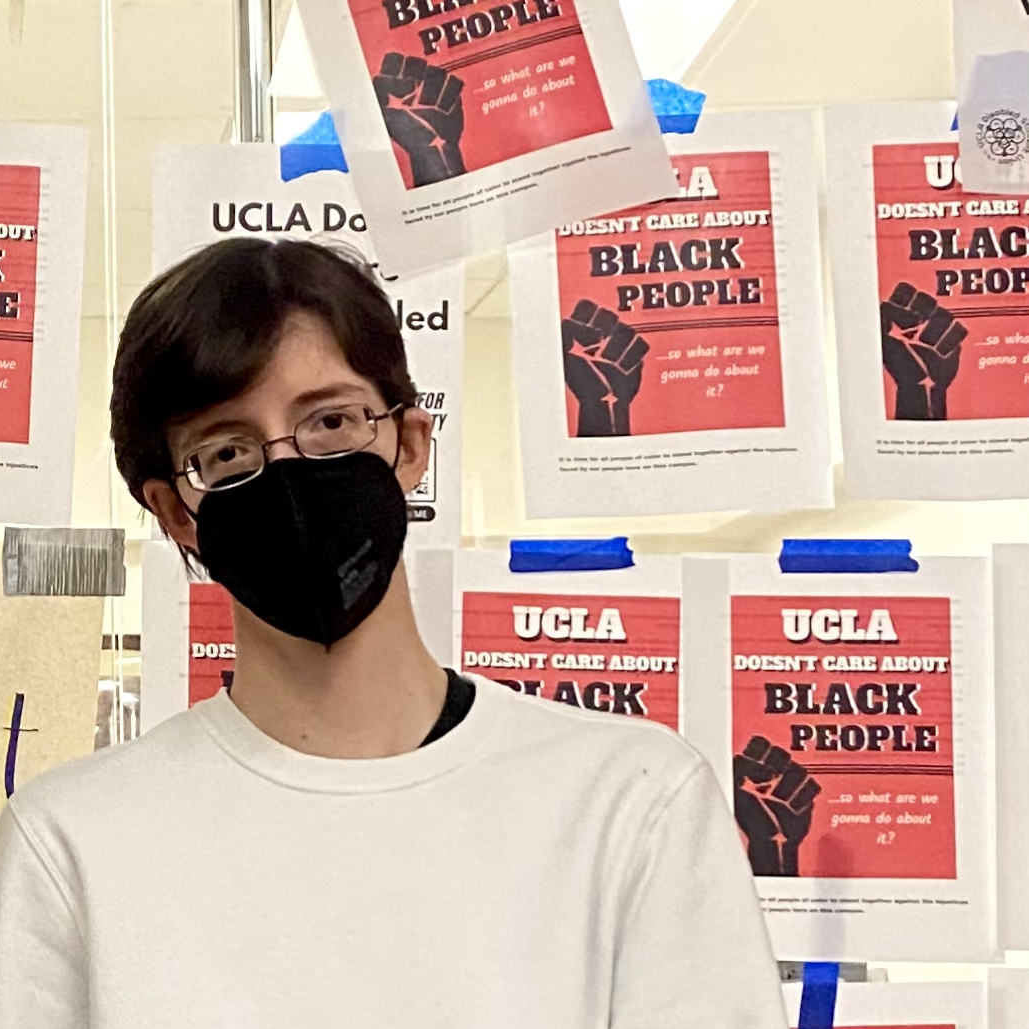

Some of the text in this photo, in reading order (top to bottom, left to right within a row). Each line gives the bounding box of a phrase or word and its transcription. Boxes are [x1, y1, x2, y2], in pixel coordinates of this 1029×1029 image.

[418, 0, 562, 56] PEOPLE
[501, 55, 576, 85] what are we
[482, 75, 575, 114] gonna do about
[529, 102, 545, 118] it?
[212, 203, 367, 232] UCLA Do
[645, 213, 698, 231] CARE
[703, 210, 769, 227] ABOUT
[966, 200, 1018, 217] CARE
[589, 237, 744, 278] BLACK
[908, 227, 1029, 261] BLAC
[617, 277, 761, 312] PEOPLE
[0, 359, 16, 369] we
[687, 345, 718, 358] what
[660, 364, 759, 383] gonna about
[513, 606, 626, 643] UCLA
[781, 608, 899, 644] UCLA
[552, 654, 605, 671] CARE
[609, 656, 676, 673] ABOUT
[822, 656, 877, 672] CARE
[882, 657, 948, 673] ABOUT
[764, 682, 921, 715] BLACK
[790, 724, 939, 752] PEOPLE
